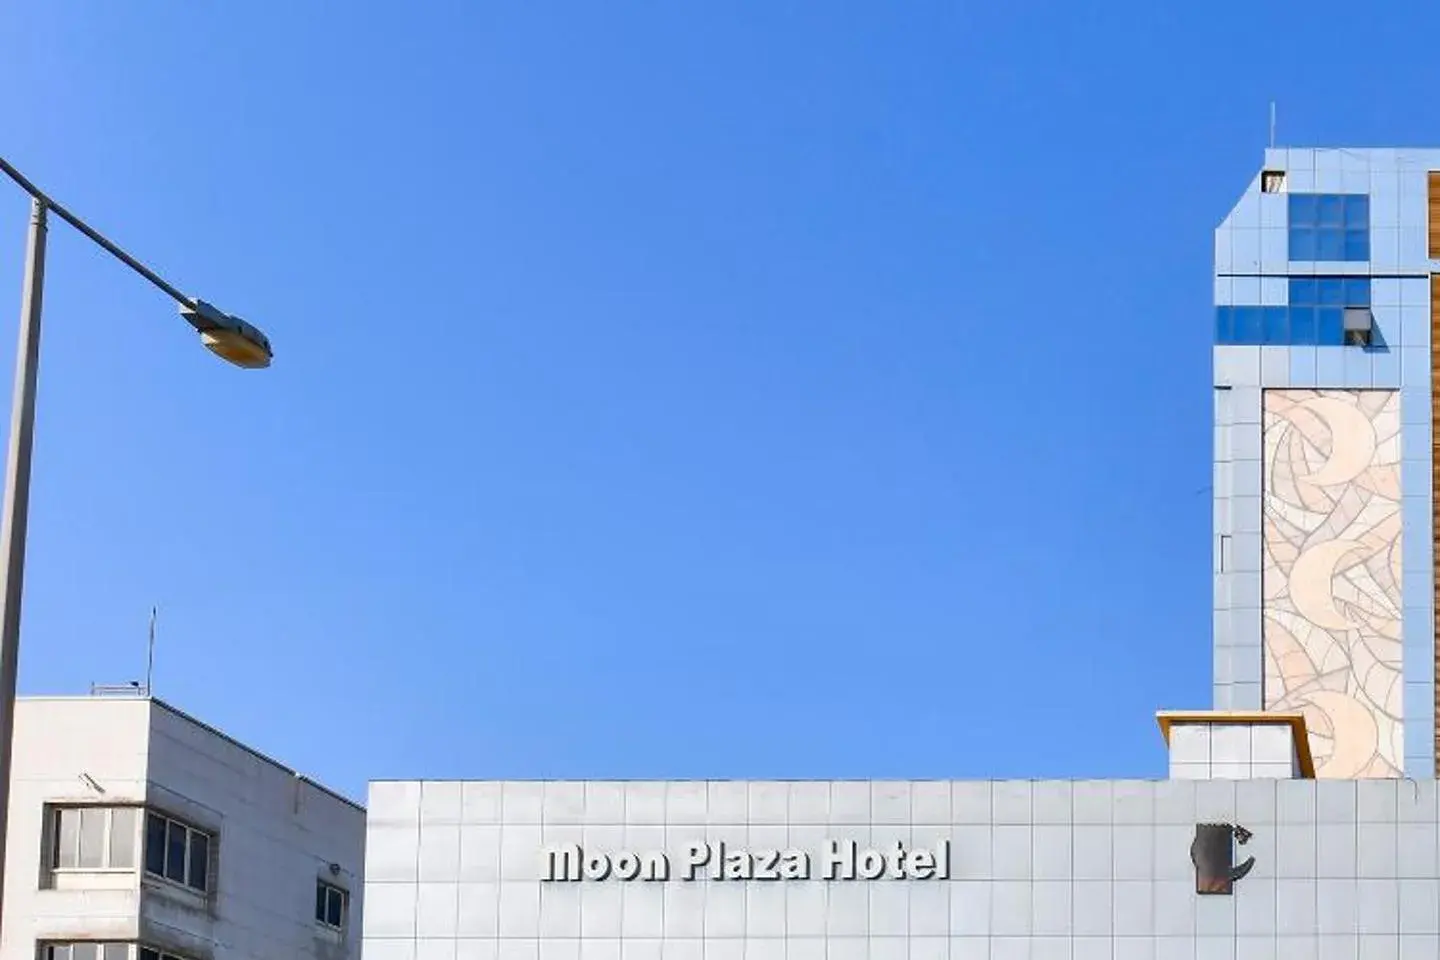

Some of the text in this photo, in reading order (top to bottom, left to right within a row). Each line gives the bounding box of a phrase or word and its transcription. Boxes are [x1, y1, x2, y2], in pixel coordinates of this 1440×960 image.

[541, 840, 952, 882] Moon Plaza Hotel
